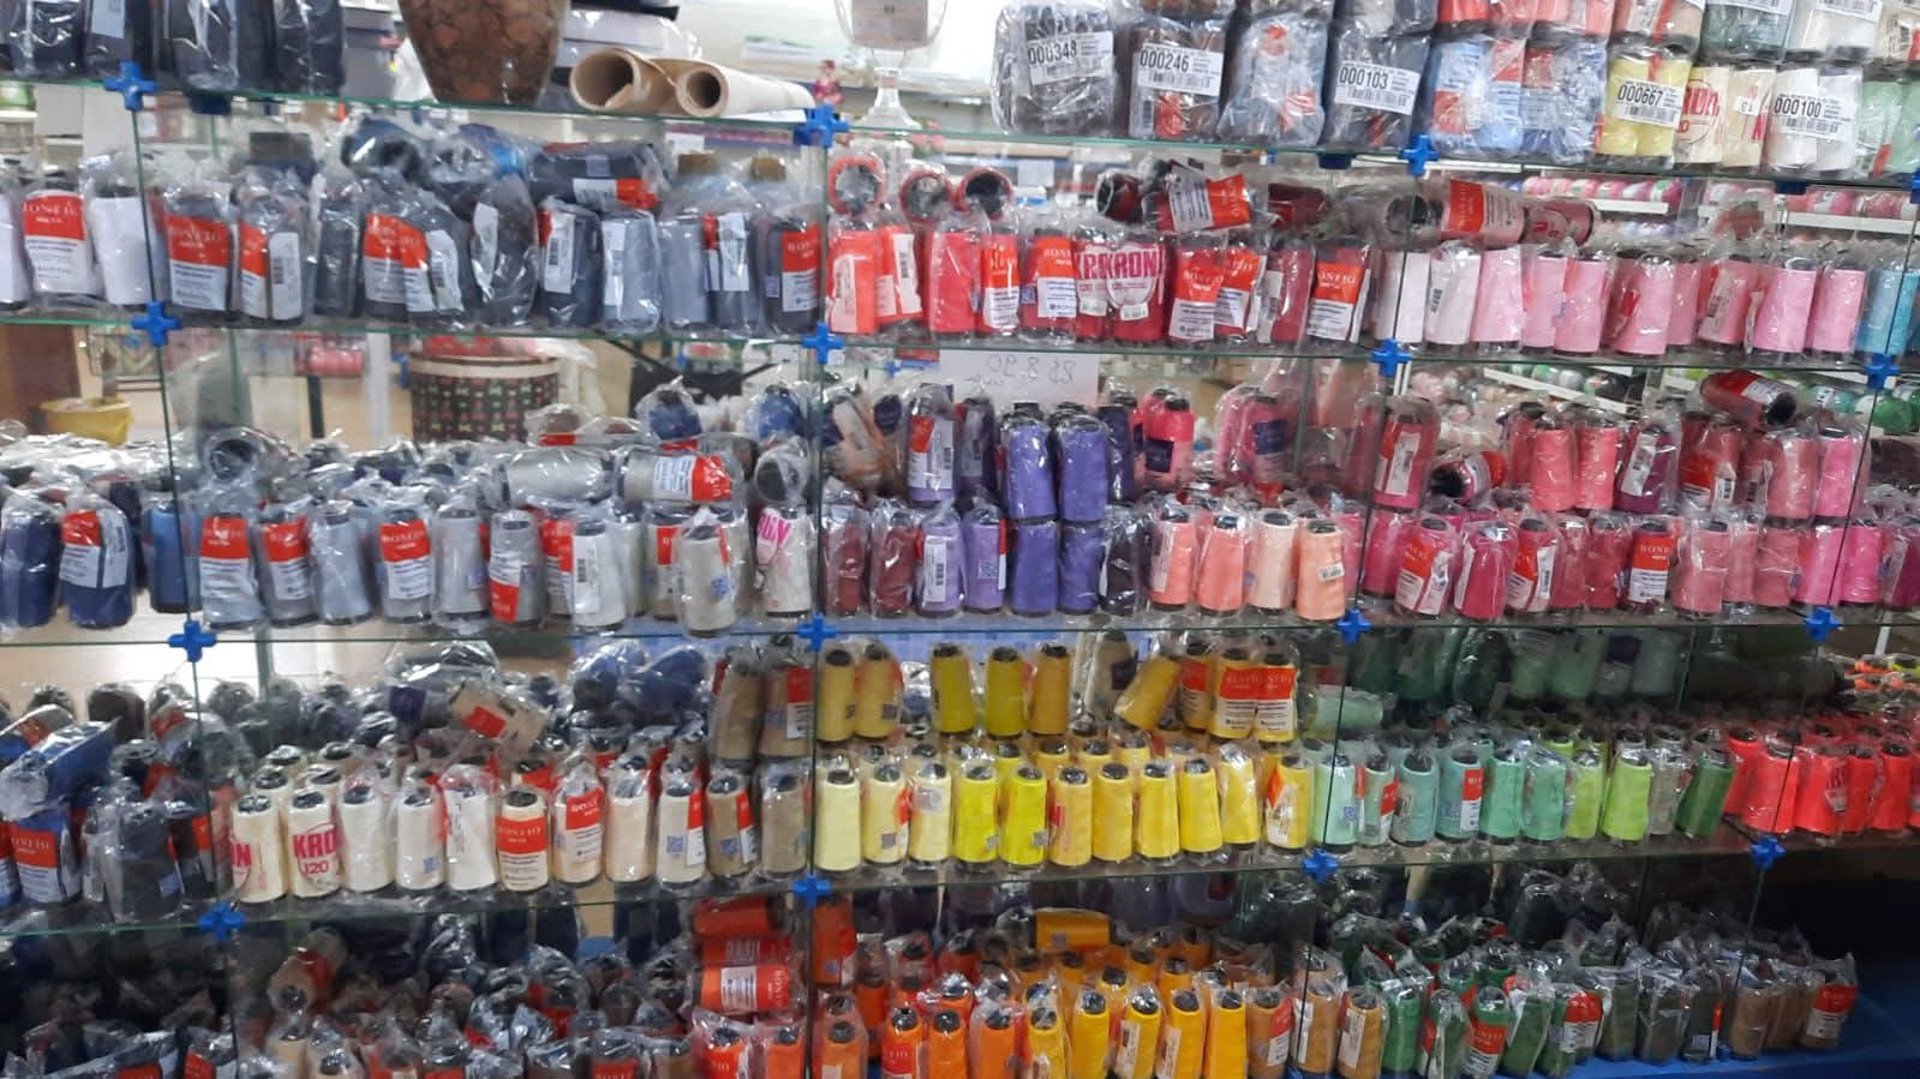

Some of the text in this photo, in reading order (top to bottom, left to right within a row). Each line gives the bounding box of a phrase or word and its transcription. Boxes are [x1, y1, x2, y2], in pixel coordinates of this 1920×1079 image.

[1028, 40, 1077, 65] 000348
[1140, 50, 1189, 72] 000246
[1339, 67, 1388, 90] 000103
[1617, 85, 1663, 106] 000667
[1774, 97, 1822, 118] 000100
